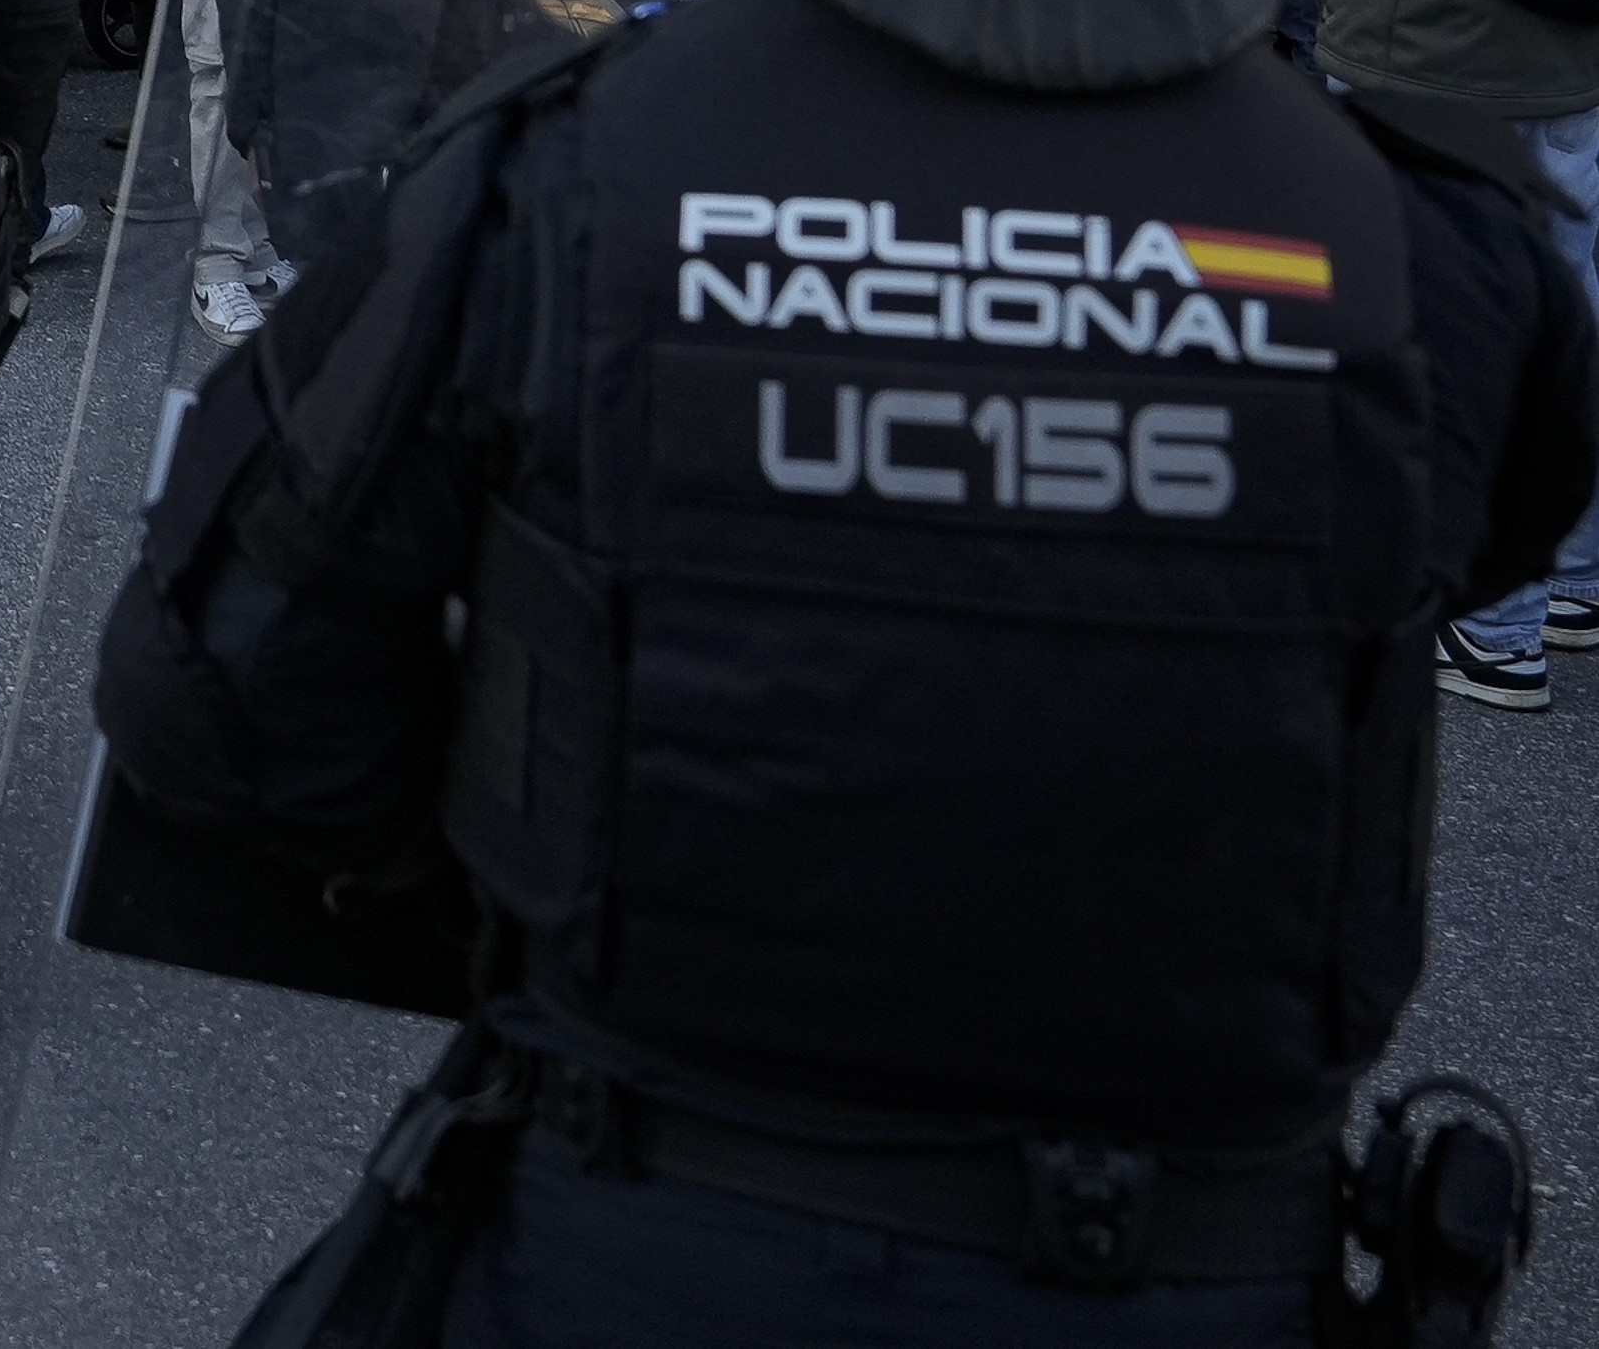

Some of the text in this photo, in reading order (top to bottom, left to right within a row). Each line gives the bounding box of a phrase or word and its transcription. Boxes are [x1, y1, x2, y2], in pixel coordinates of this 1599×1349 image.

[680, 191, 1205, 287] POLICIA
[678, 259, 1338, 371] NACIONAL
[757, 379, 1239, 520] UC156
